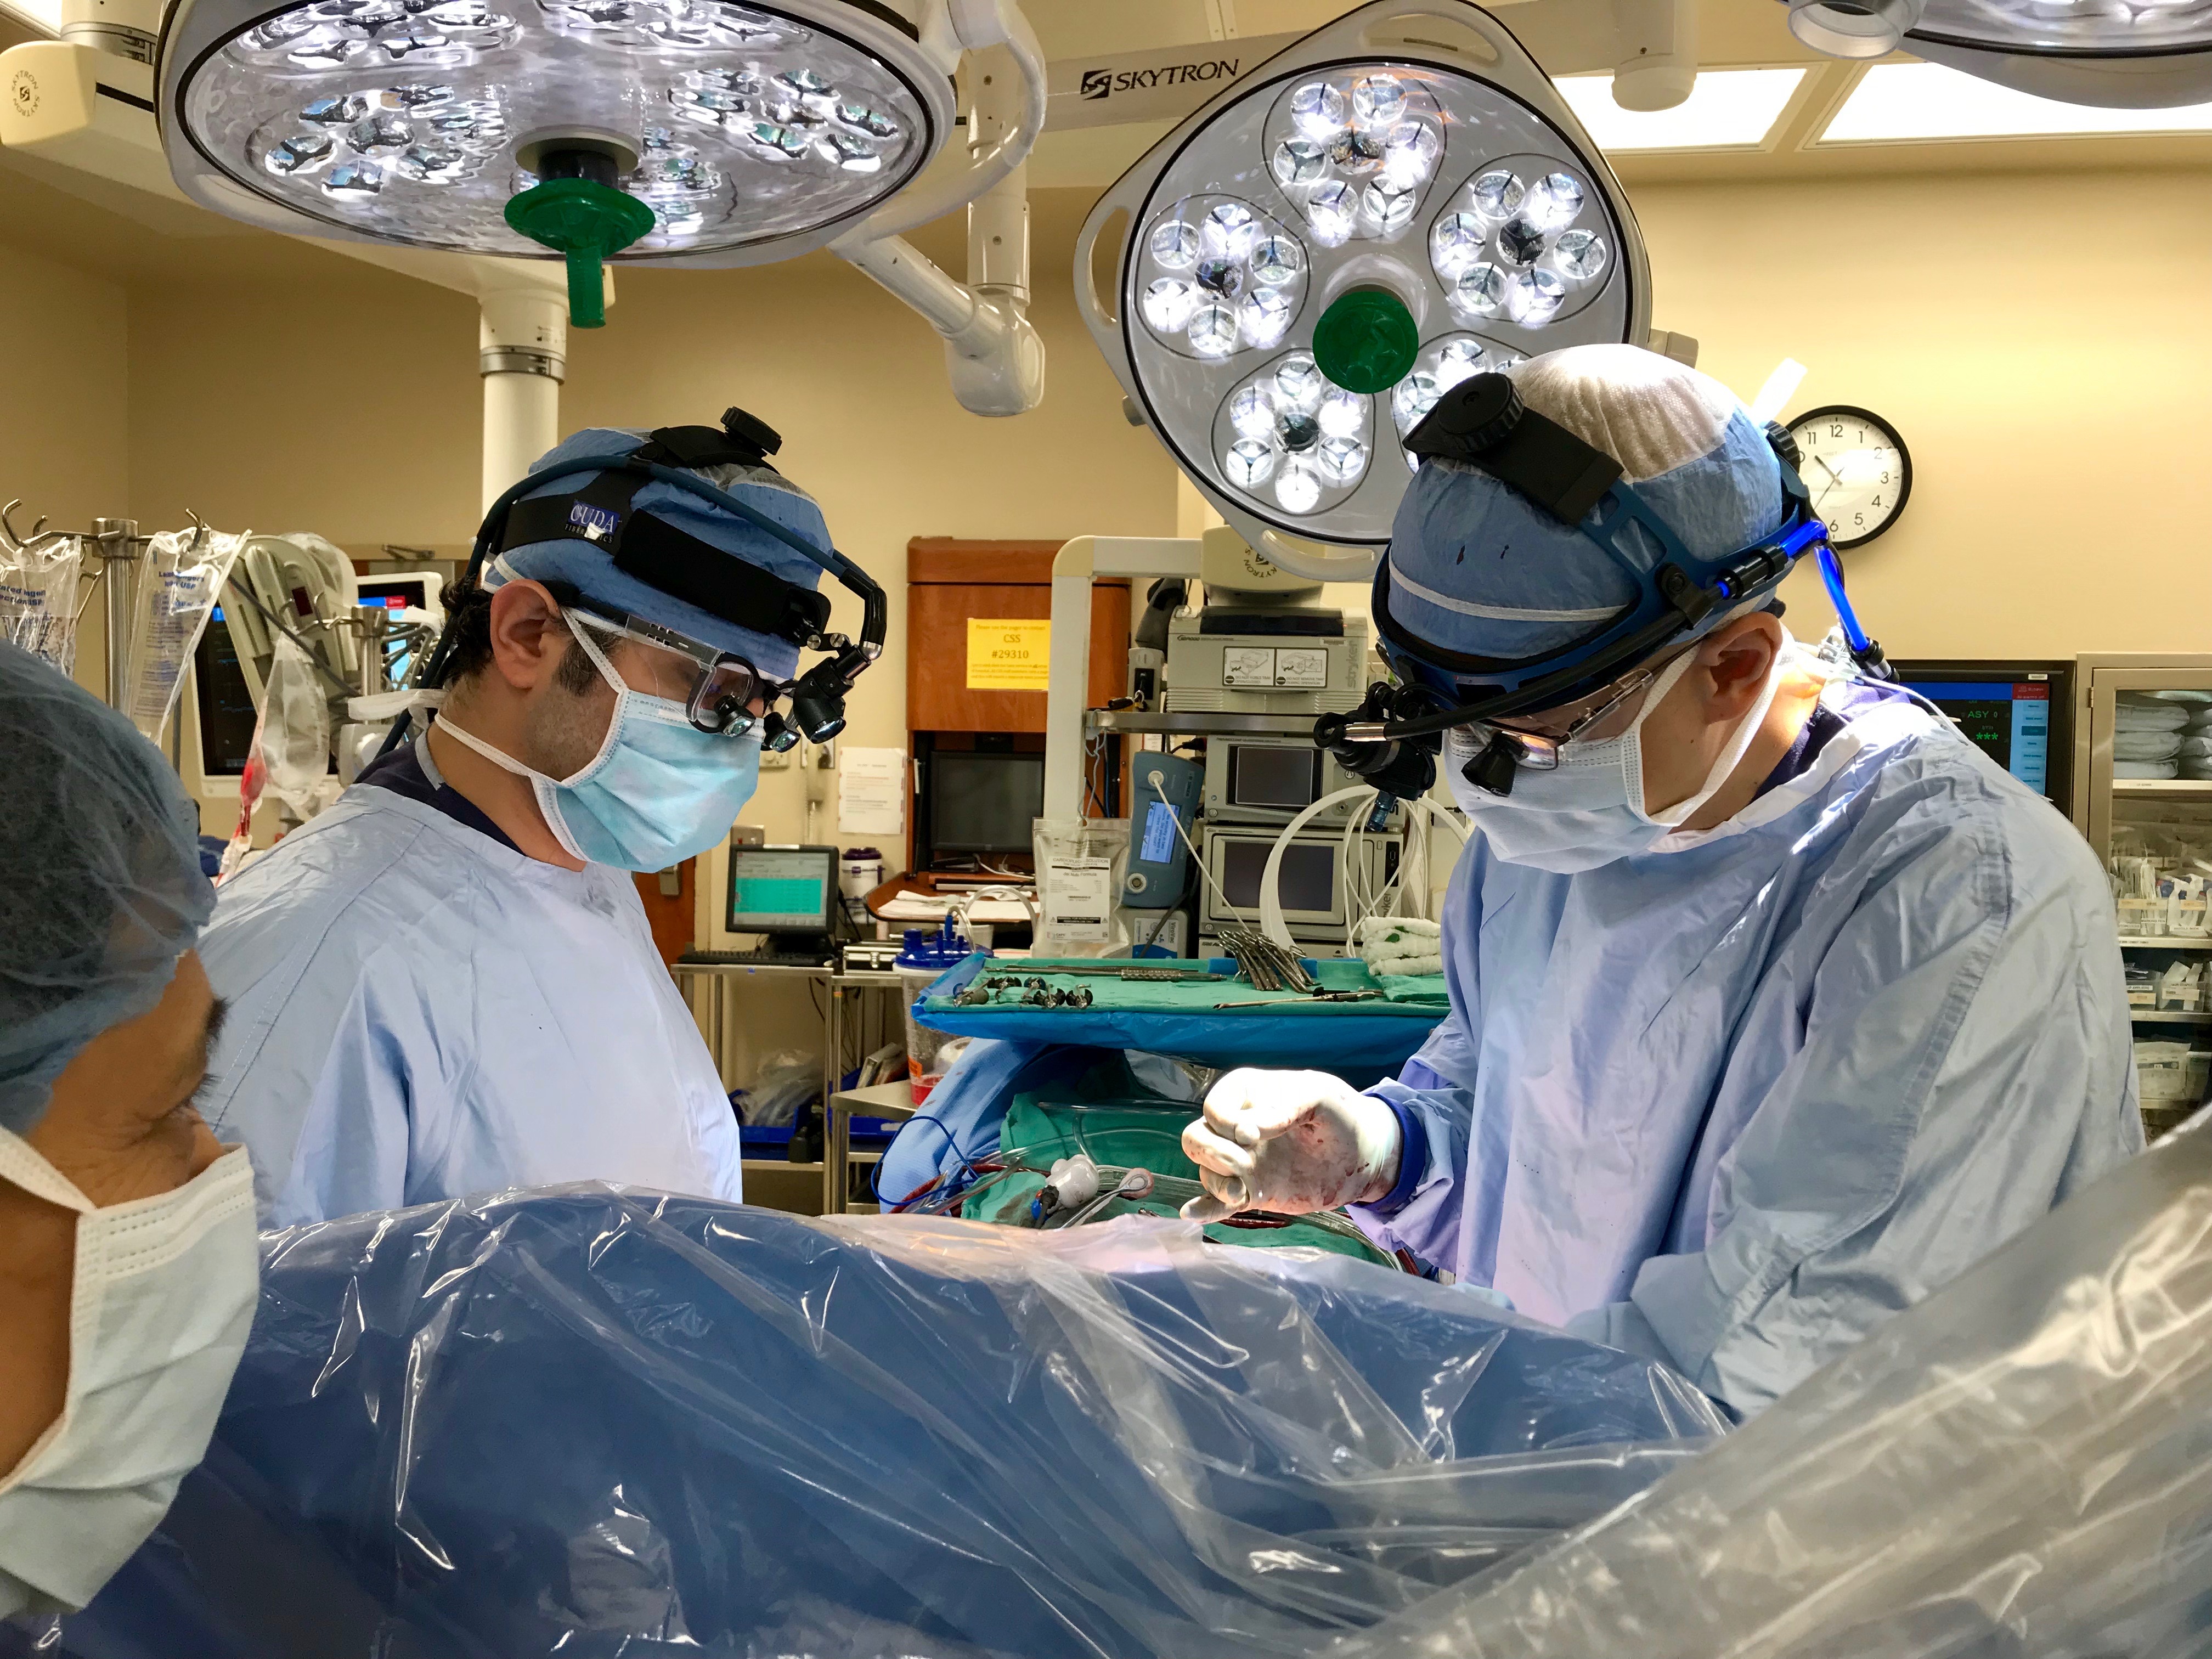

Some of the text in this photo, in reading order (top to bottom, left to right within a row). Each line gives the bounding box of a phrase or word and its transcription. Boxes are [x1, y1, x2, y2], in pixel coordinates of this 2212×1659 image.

[12, 70, 39, 93] SKYTRON
[1114, 59, 1239, 92] SKYTRON
[1807, 431, 1863, 444] 11 1
[1830, 424, 1843, 438] 12
[1874, 447, 1883, 460] 2
[1880, 471, 1889, 484] 3
[1871, 495, 1882, 507] 4
[571, 504, 613, 533] CUDA
[1854, 512, 1864, 526] 5
[1830, 520, 1839, 532] 6
[1003, 634, 1021, 643] CSS
[991, 650, 1029, 659] #29310
